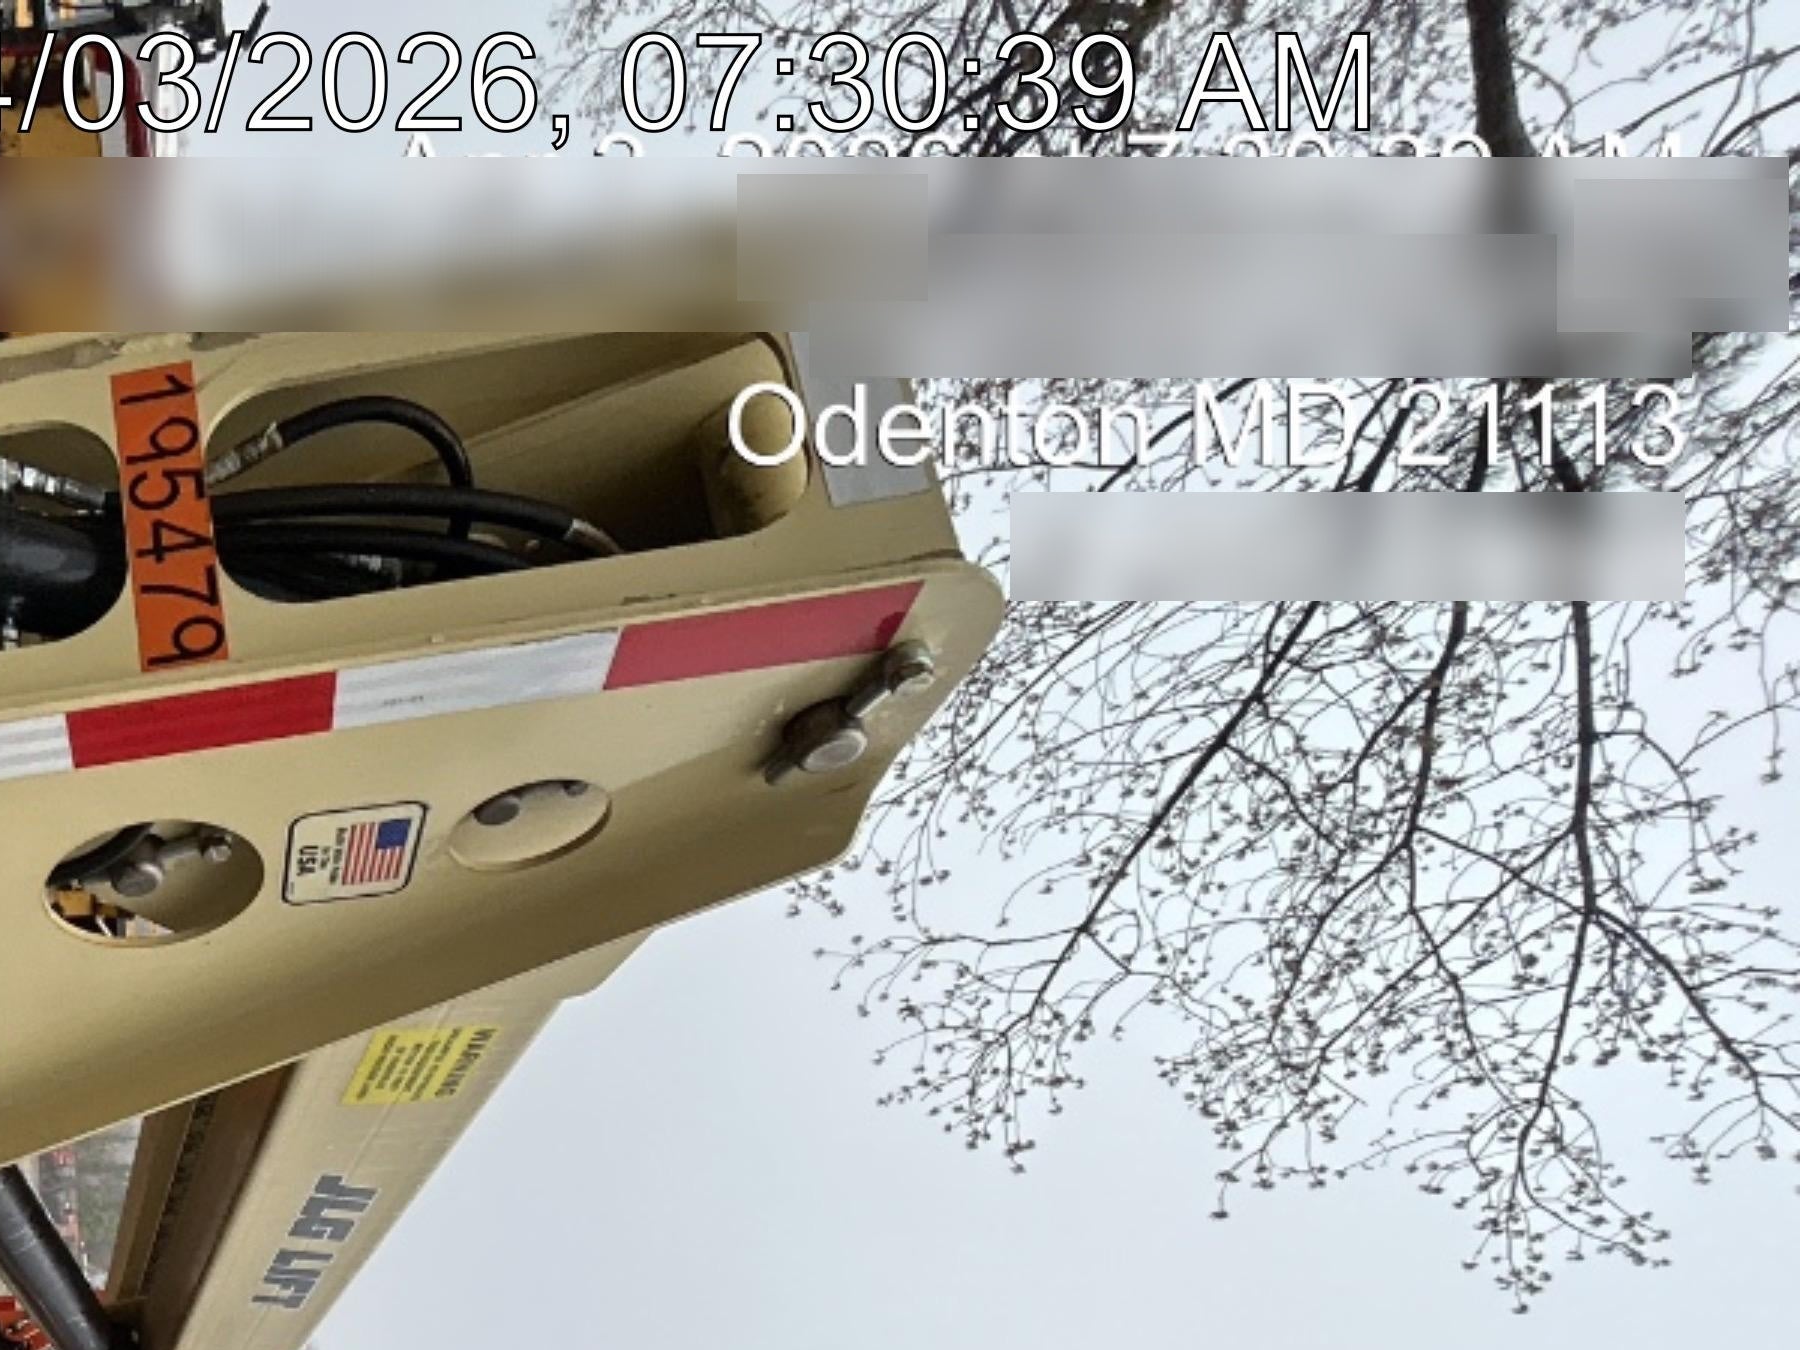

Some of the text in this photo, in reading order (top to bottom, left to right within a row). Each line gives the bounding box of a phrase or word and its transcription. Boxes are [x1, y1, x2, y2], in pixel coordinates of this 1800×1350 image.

[119, 374, 226, 668] 195479
[296, 845, 319, 876] USA
[434, 1028, 497, 1098] WARNING
[251, 1173, 380, 1310] JLG LIFT
